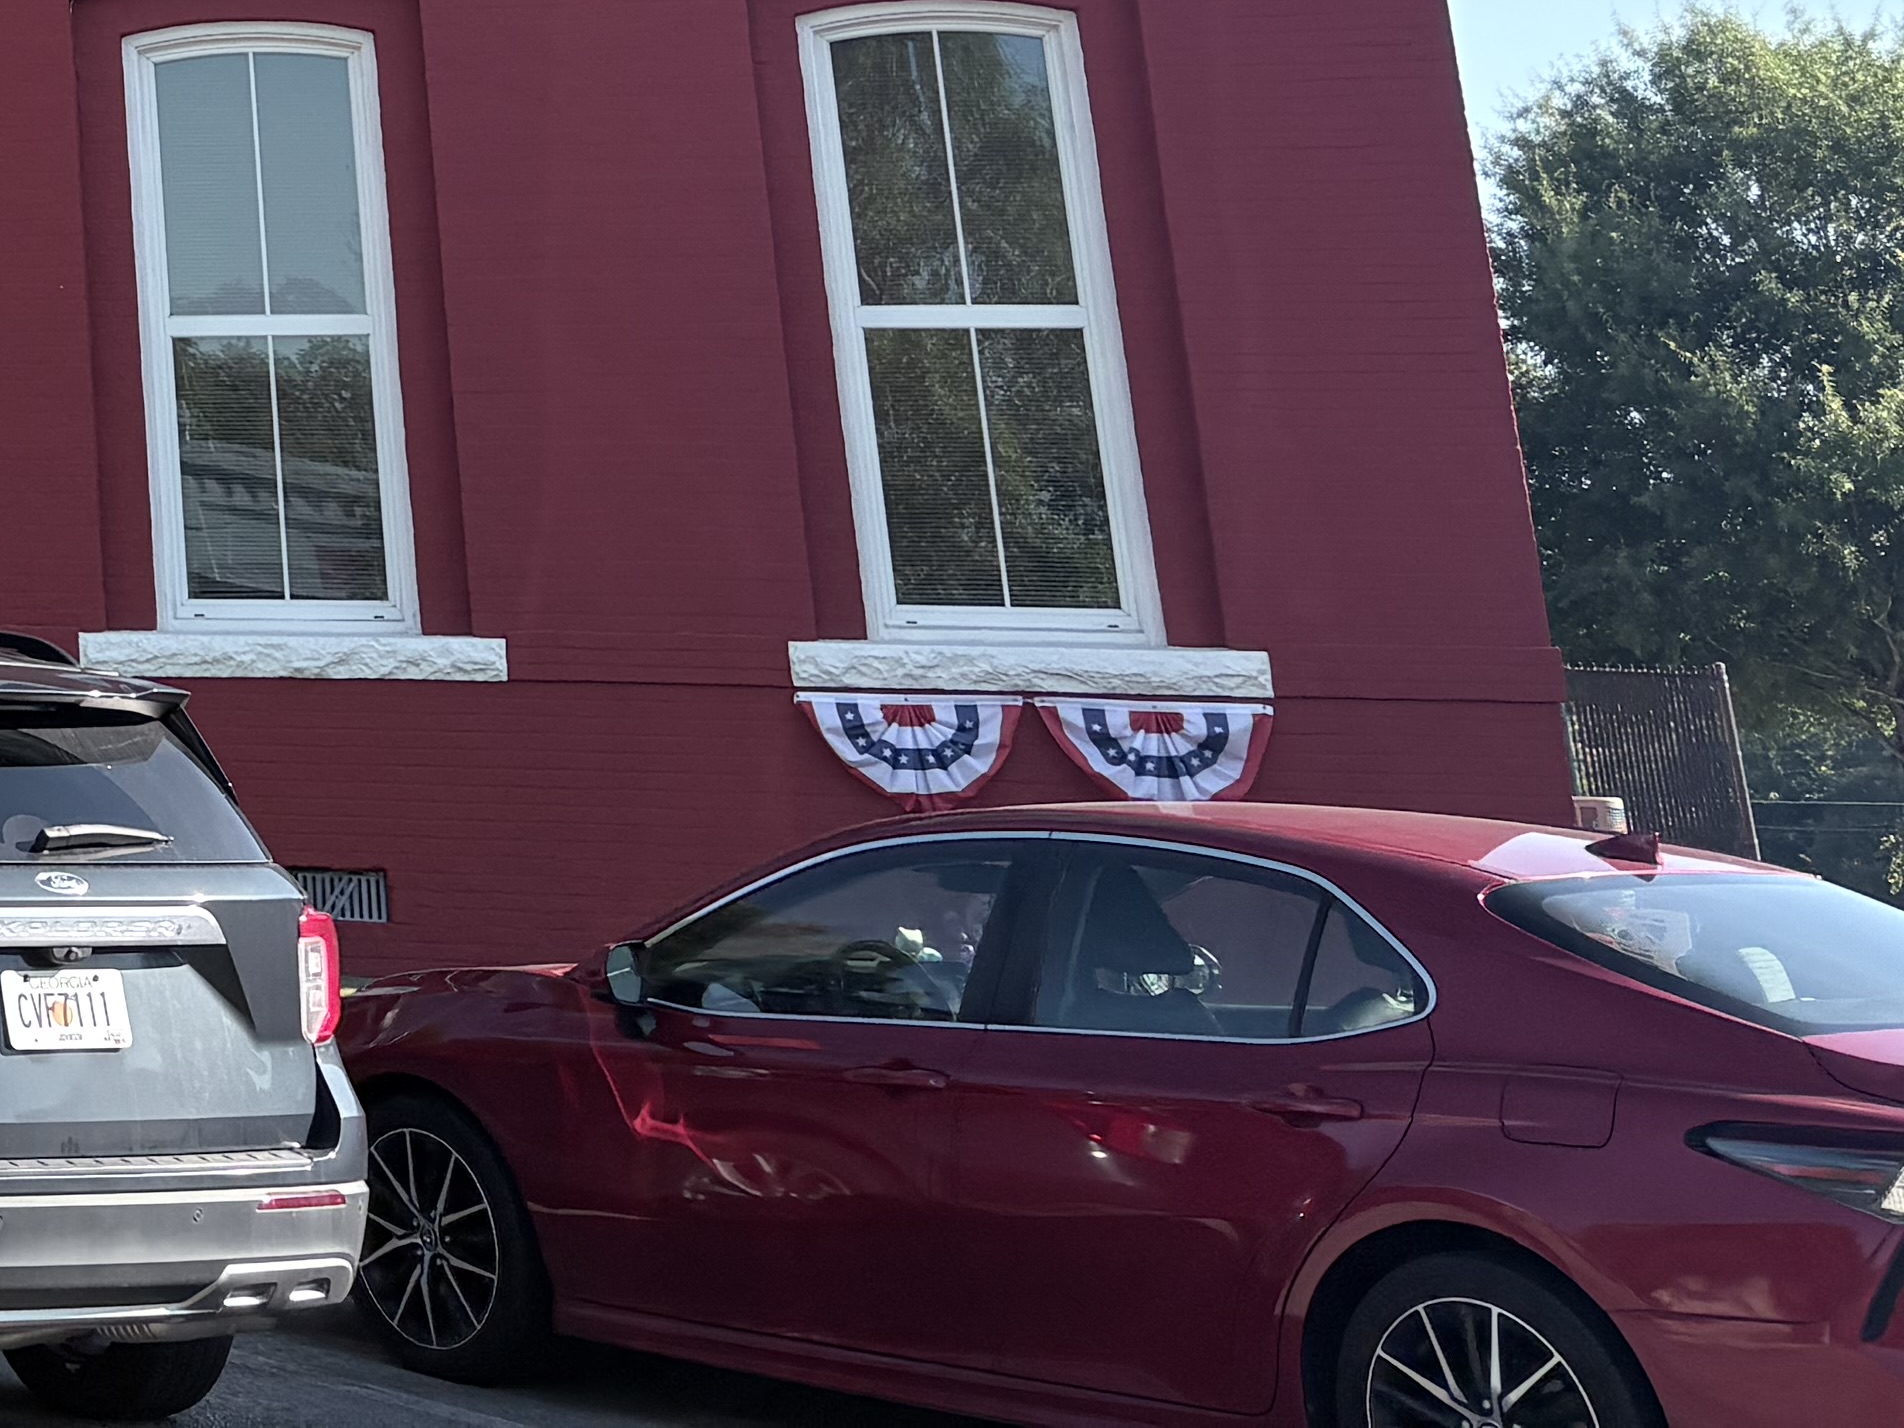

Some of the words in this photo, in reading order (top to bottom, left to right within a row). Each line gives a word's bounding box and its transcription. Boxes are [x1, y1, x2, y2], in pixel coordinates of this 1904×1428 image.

[45, 874, 86, 892] Ford
[28, 975, 94, 990] GEORGIA
[18, 992, 111, 1028] CVF7111
